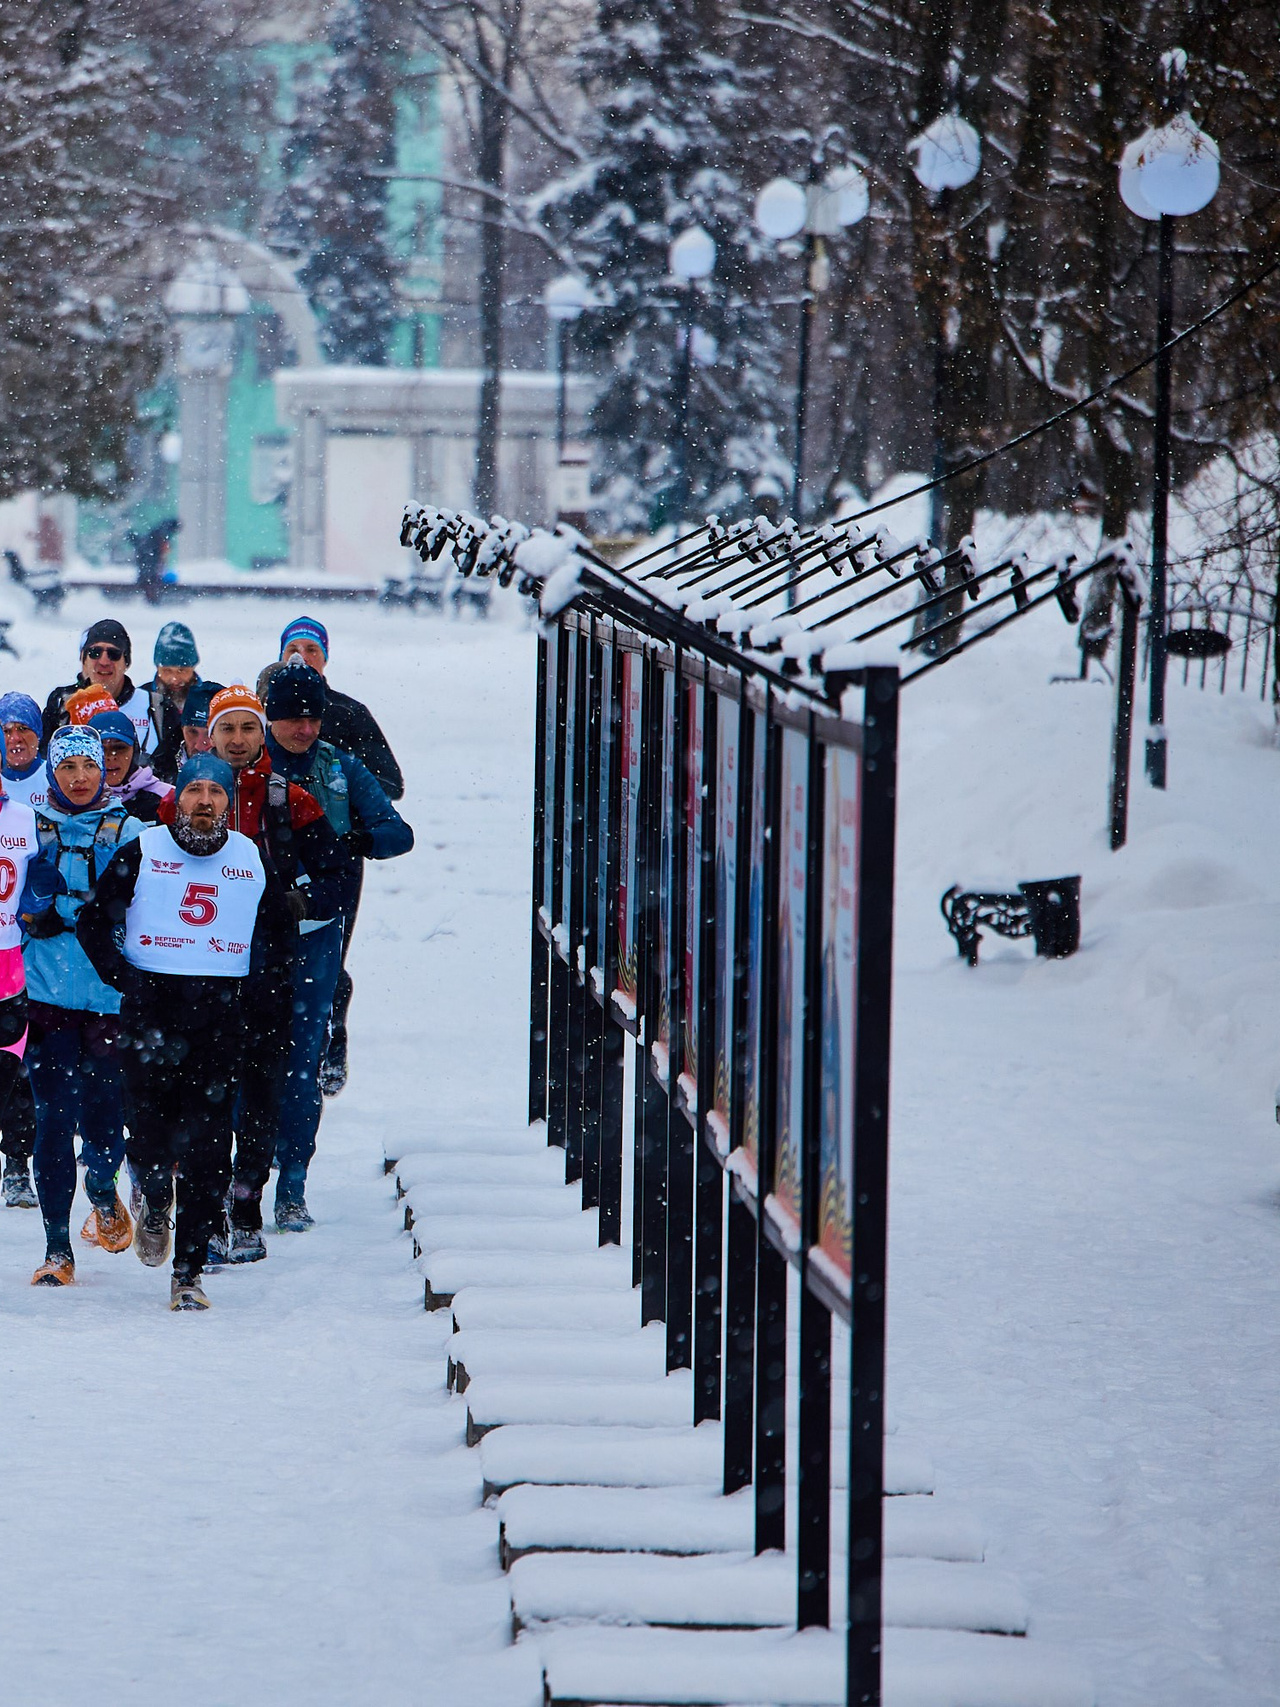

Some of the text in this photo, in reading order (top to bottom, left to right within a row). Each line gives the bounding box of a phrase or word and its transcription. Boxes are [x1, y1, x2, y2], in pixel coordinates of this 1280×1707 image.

[179, 882, 218, 927] 5
[154, 936, 195, 944] ВЕРТОЛЕТЫ
[154, 941, 182, 949] РОССИИ
